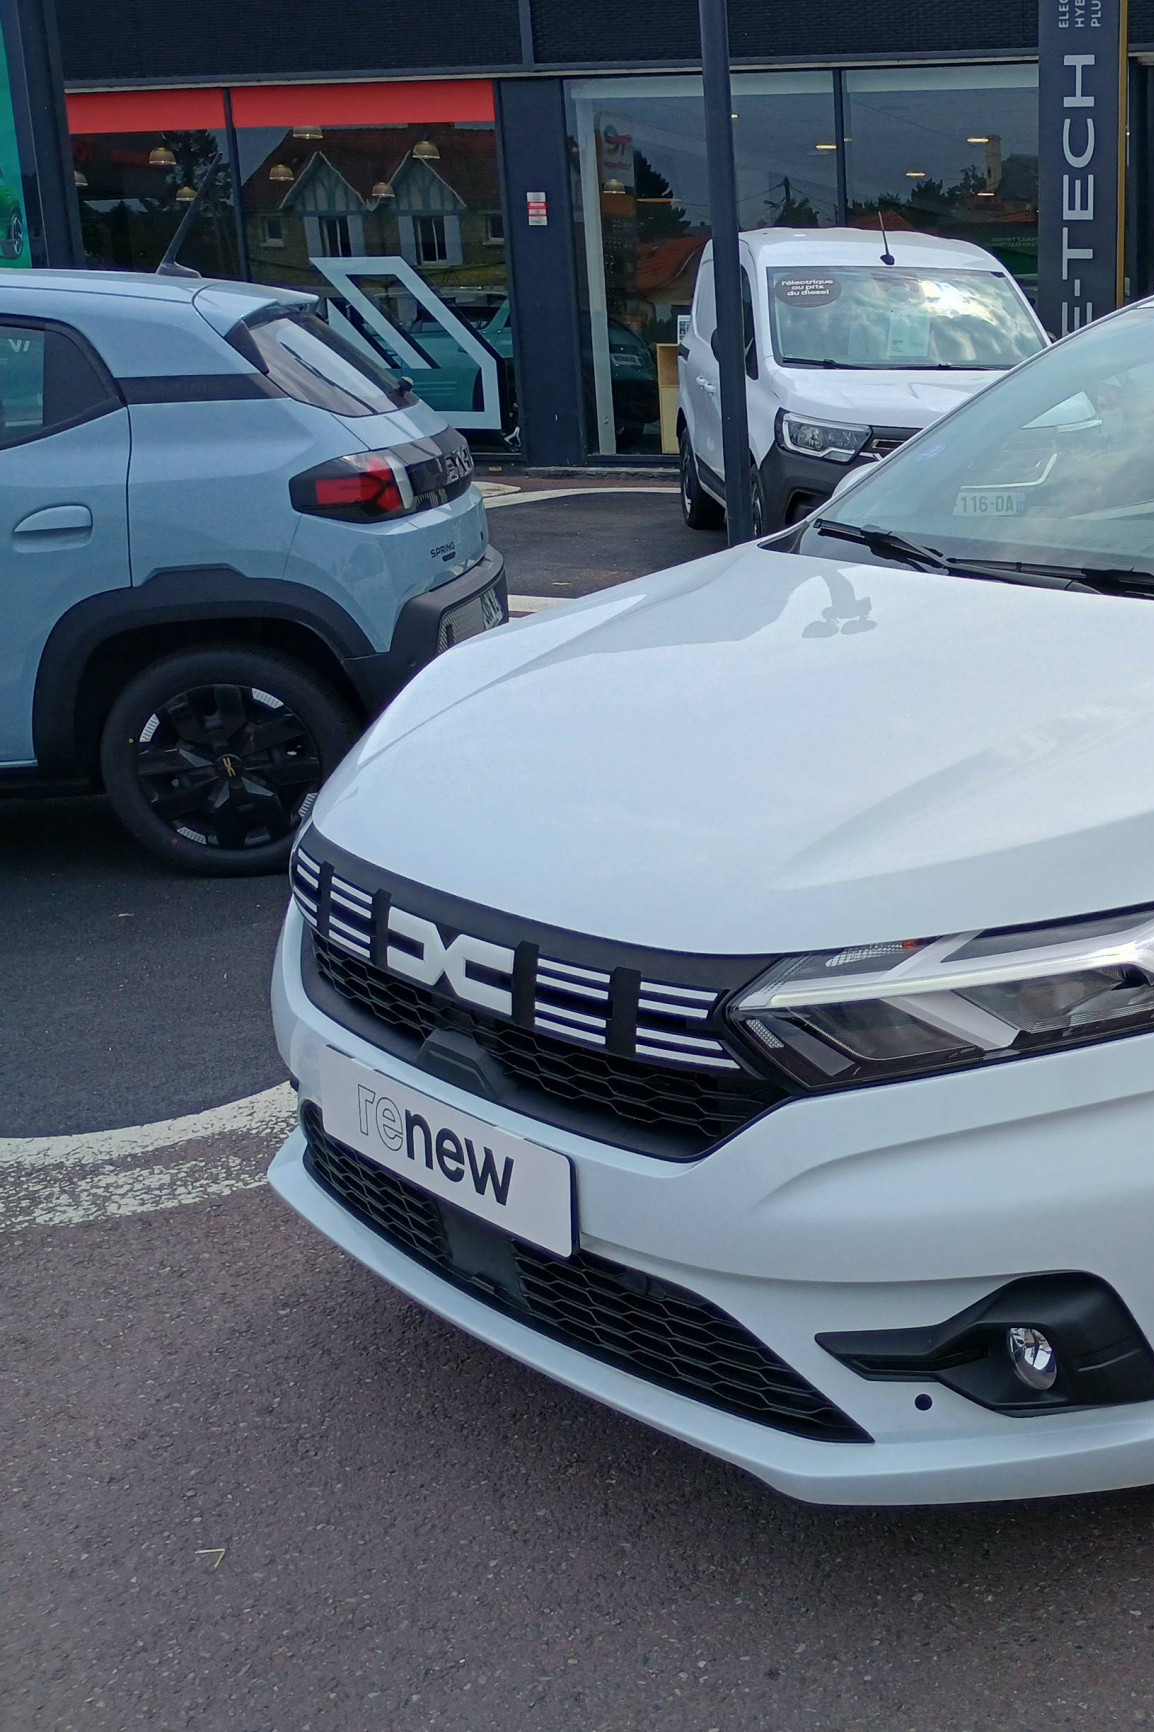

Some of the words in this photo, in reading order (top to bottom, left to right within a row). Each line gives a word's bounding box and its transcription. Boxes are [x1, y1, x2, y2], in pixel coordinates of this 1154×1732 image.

[1061, 53, 1096, 338] E-TECH
[430, 541, 456, 558] SPRING
[357, 1083, 515, 1207] renew
